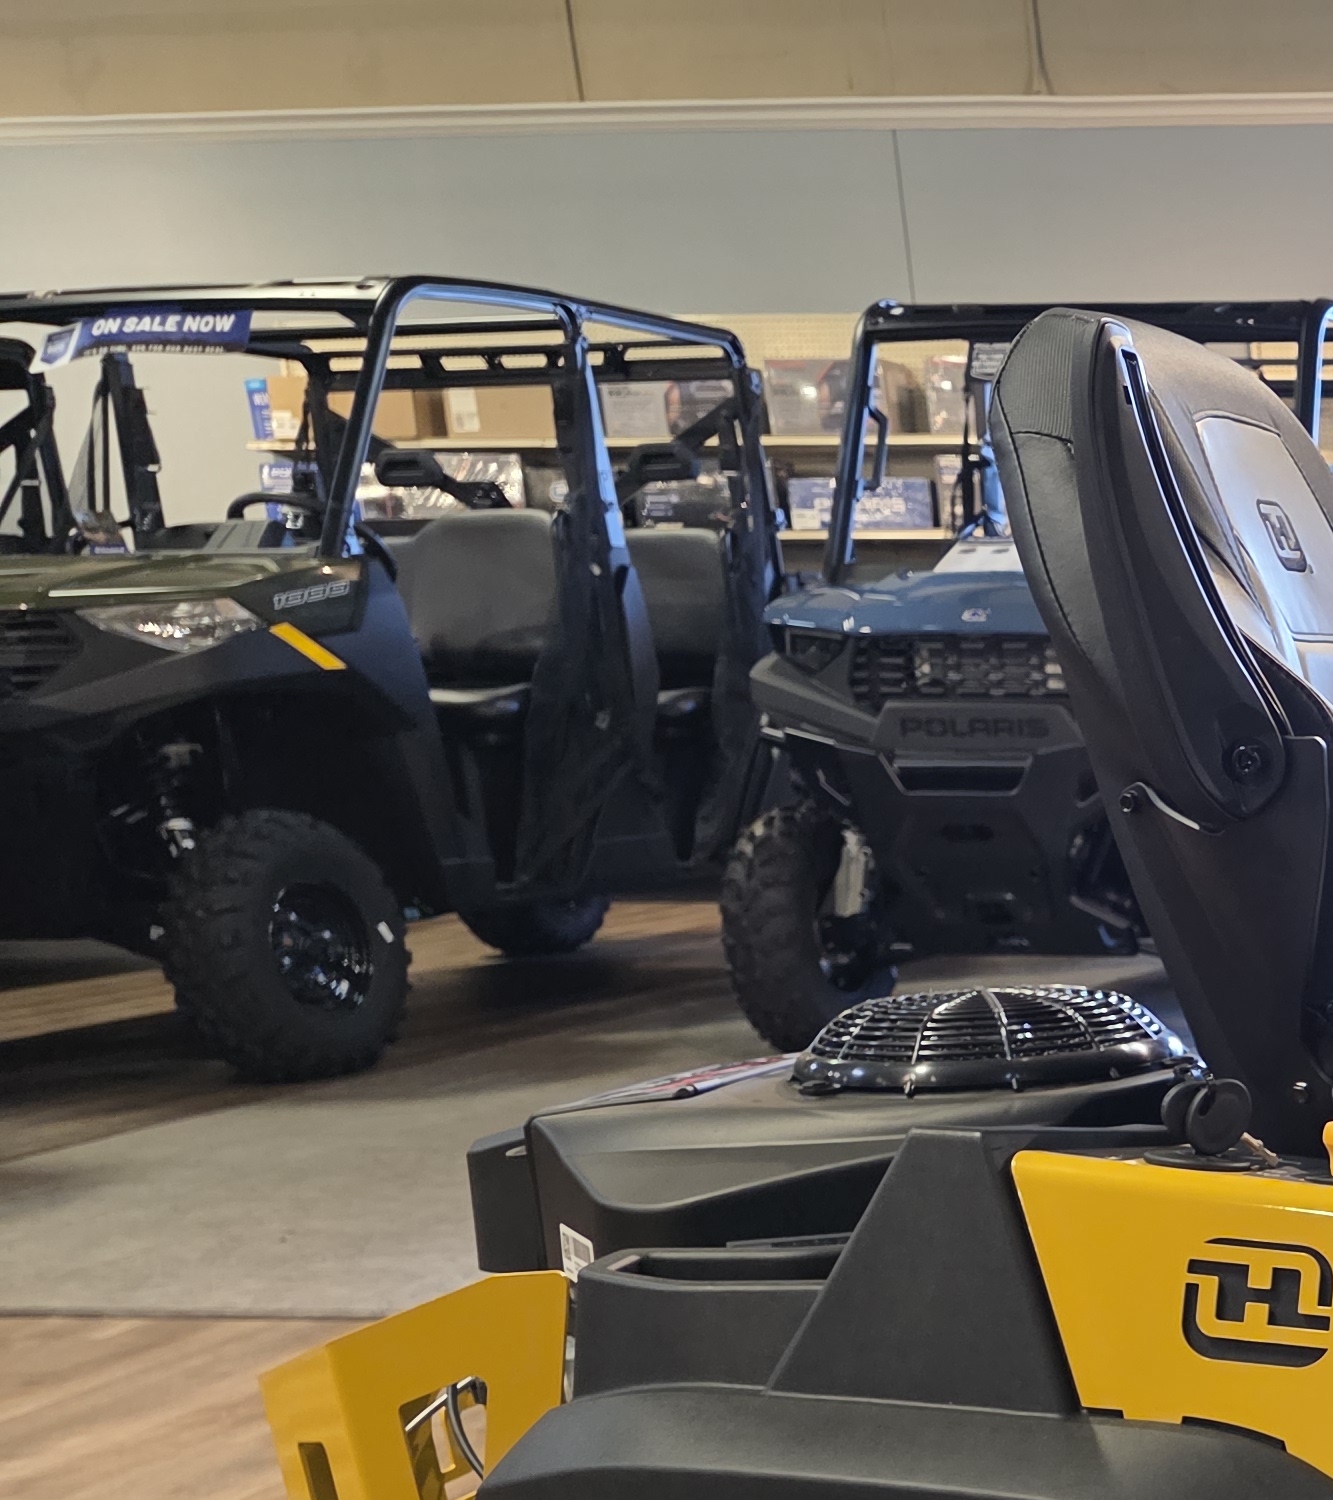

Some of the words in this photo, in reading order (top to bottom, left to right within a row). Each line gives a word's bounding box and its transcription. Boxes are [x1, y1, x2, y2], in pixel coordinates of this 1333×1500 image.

[92, 318, 121, 336] ON
[122, 316, 178, 333] SALE
[183, 313, 236, 332] NOW
[900, 717, 1050, 739] POLARIS
